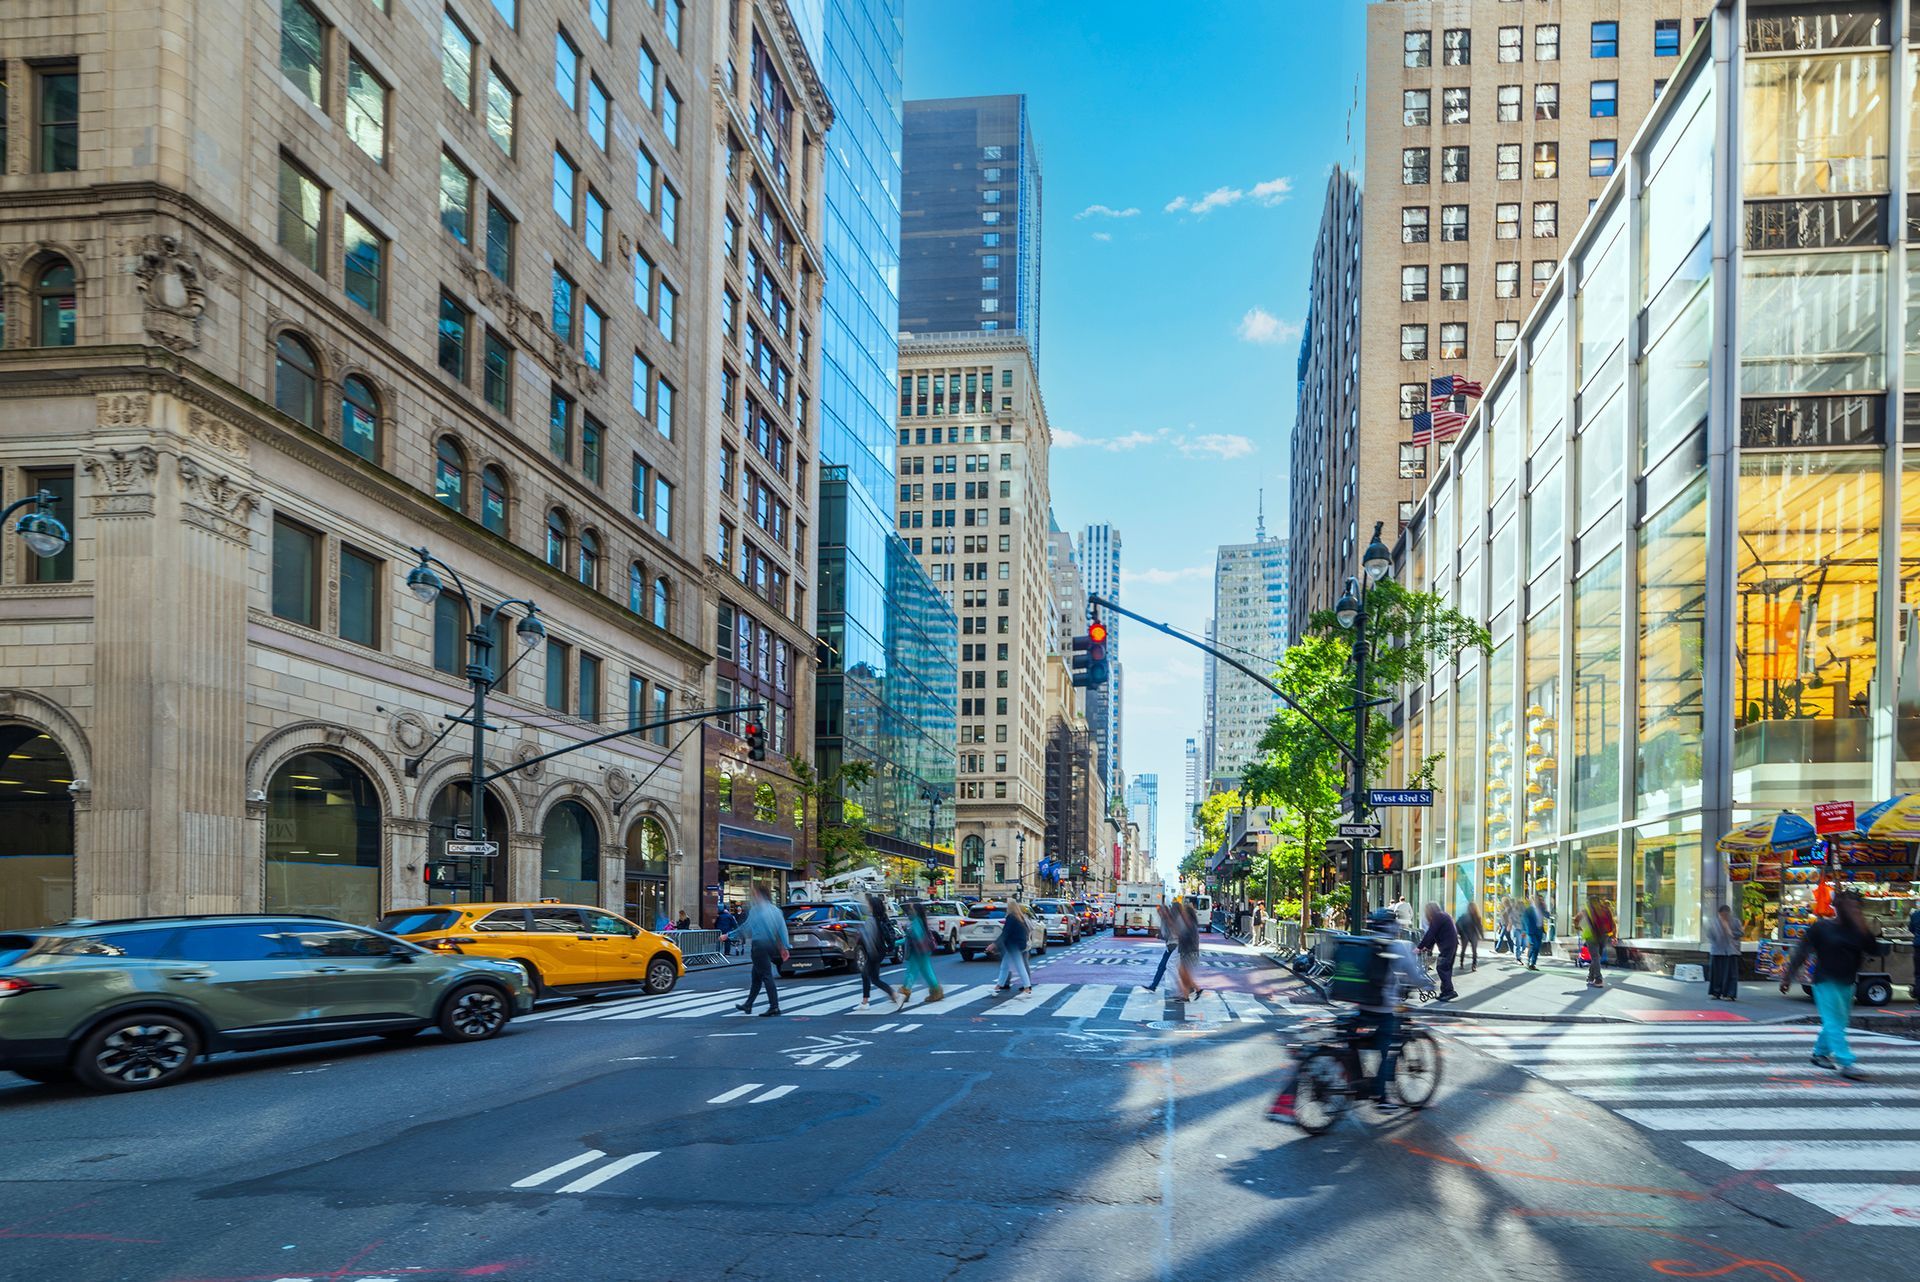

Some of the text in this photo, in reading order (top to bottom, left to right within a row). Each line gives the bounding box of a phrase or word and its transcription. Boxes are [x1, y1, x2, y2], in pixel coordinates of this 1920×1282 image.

[1373, 793, 1430, 803] West 43rd St
